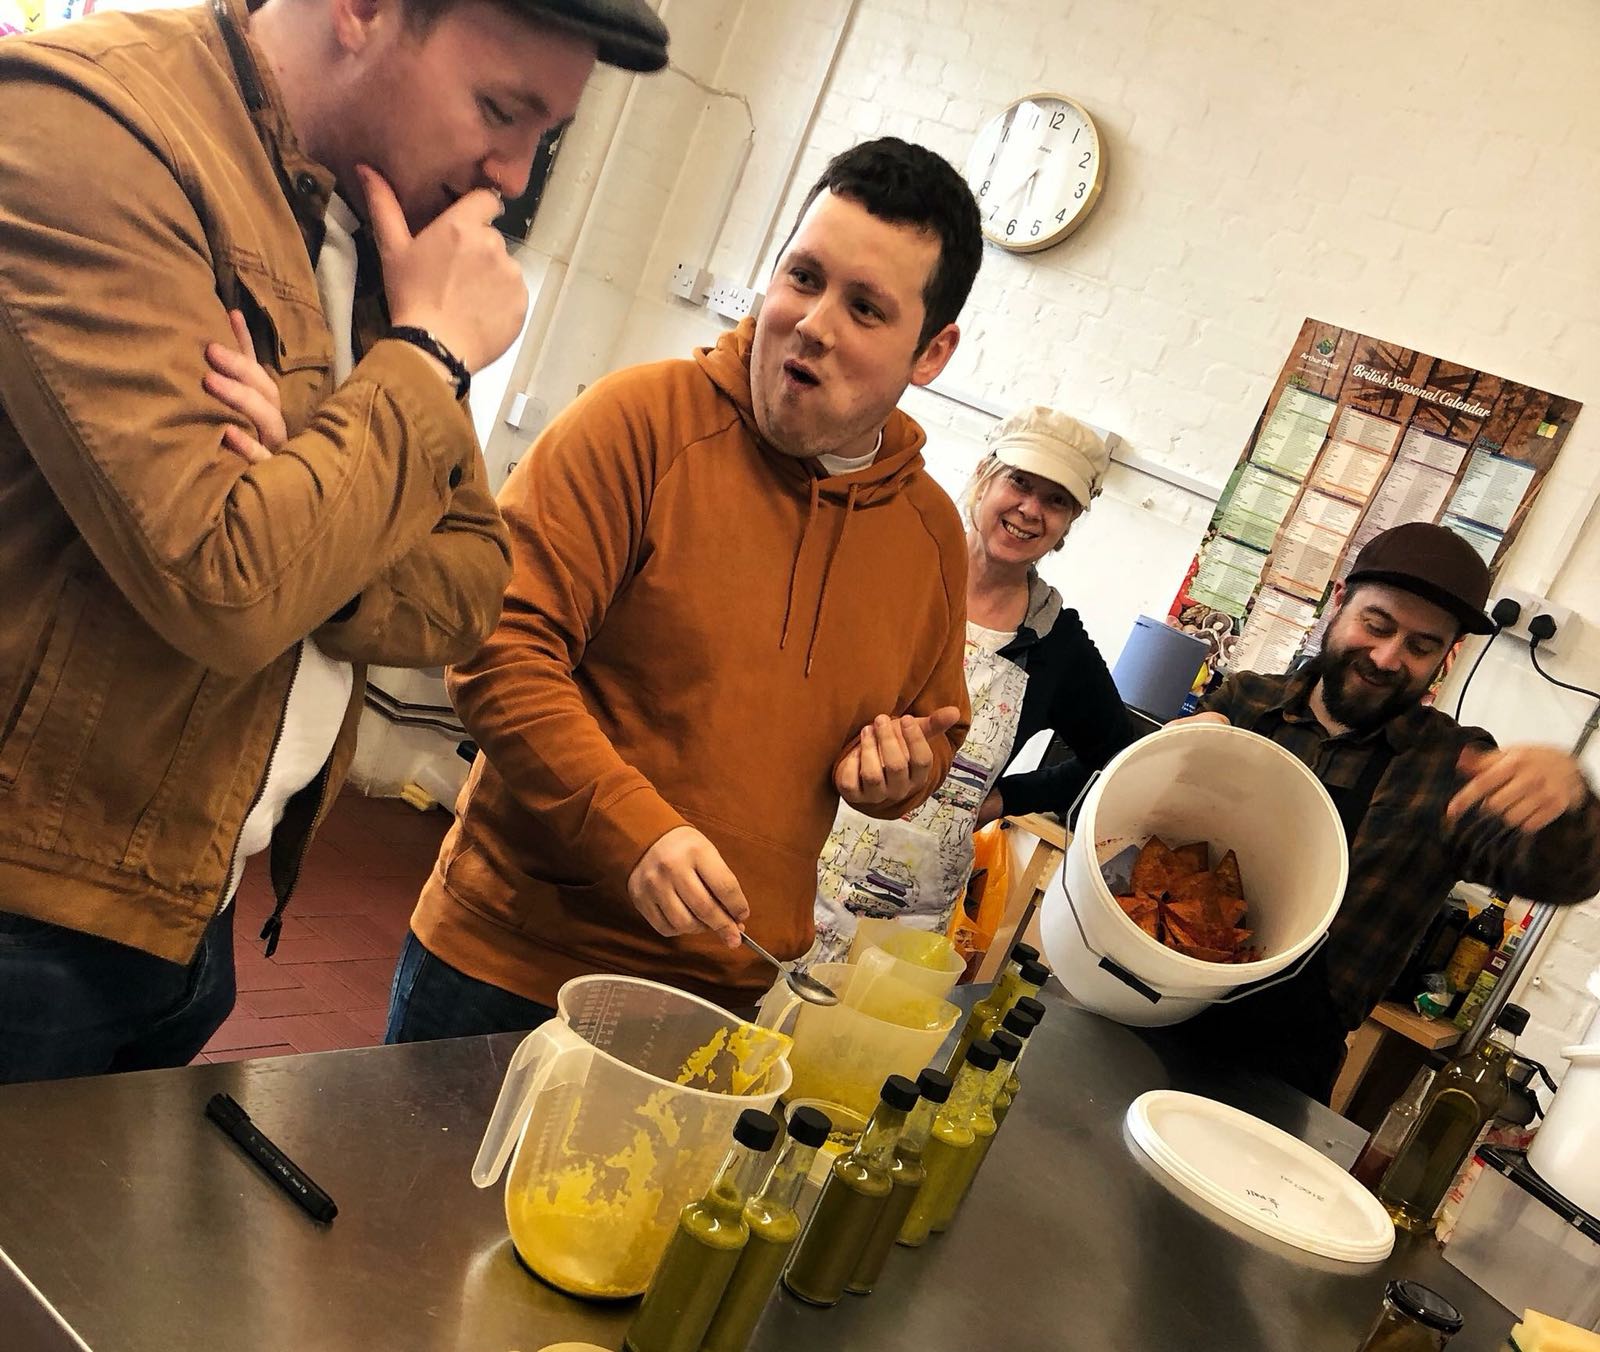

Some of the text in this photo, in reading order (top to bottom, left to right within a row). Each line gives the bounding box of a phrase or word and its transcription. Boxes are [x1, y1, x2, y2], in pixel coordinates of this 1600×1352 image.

[1027, 114, 1040, 131] 11
[1049, 112, 1065, 130] 12
[1072, 127, 1080, 144] 1
[1078, 152, 1091, 169] 2
[980, 180, 991, 197] 8
[1074, 182, 1086, 199] 3
[989, 205, 999, 221] 7
[1055, 208, 1067, 224] 4
[1006, 219, 1017, 236] 6
[1030, 220, 1042, 236] 5
[1353, 364, 1389, 388] British
[1388, 375, 1440, 403] Seasonal
[1438, 391, 1491, 418] Calendar
